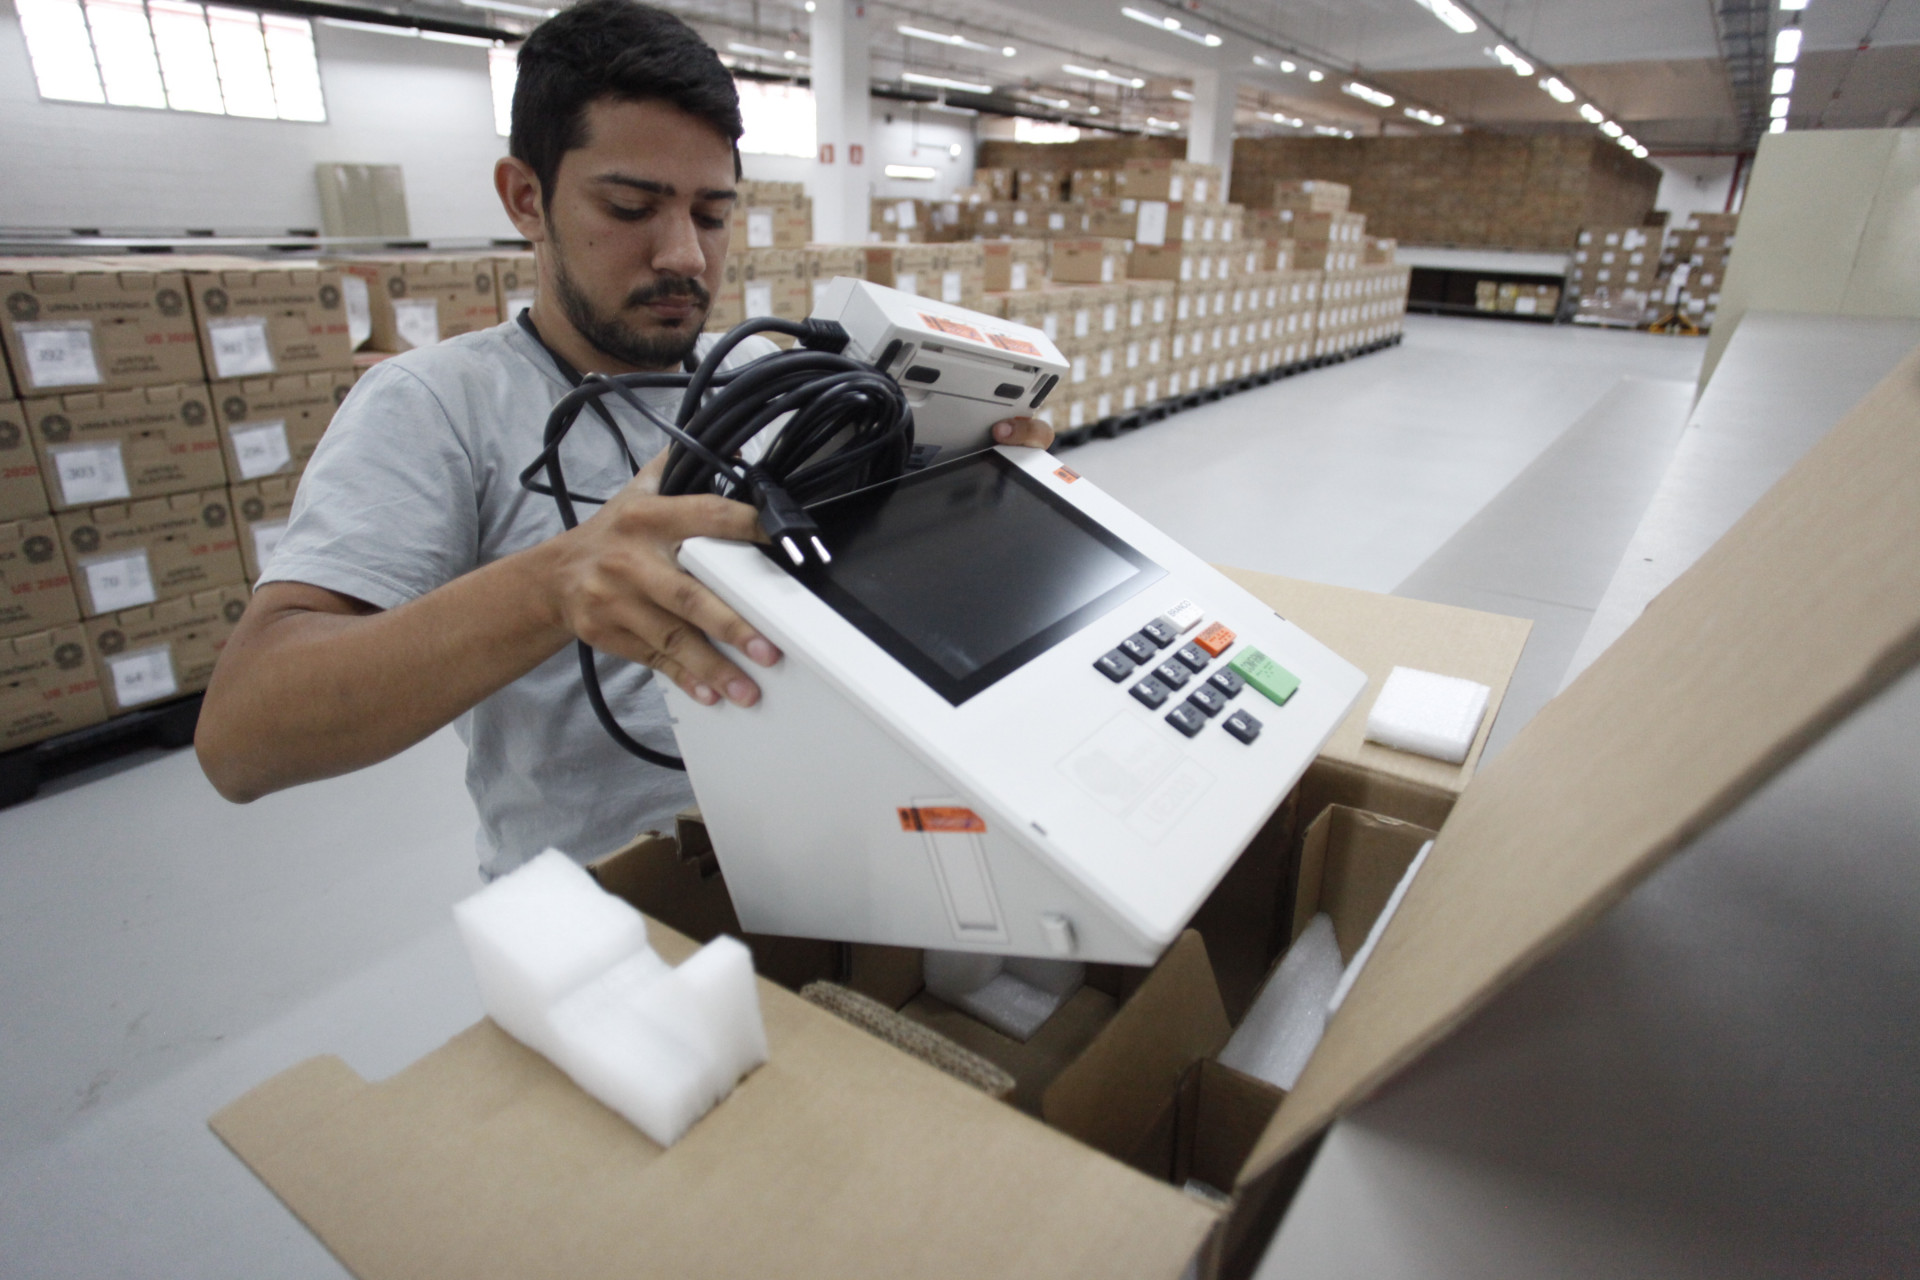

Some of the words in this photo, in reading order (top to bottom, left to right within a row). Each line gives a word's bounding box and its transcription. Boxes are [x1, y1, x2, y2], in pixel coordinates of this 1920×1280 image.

[46, 302, 80, 312] URNA
[145, 333, 163, 345] UE
[1146, 624, 1161, 636] 3
[1125, 639, 1141, 652] 2
[1180, 648, 1195, 660] 6
[1103, 656, 1117, 667] 1
[1159, 664, 1175, 677] 5
[1214, 673, 1229, 686] 9
[1138, 682, 1153, 695] 4
[1194, 690, 1211, 703] 8
[1173, 709, 1189, 723] 7
[1230, 717, 1247, 731] 0
